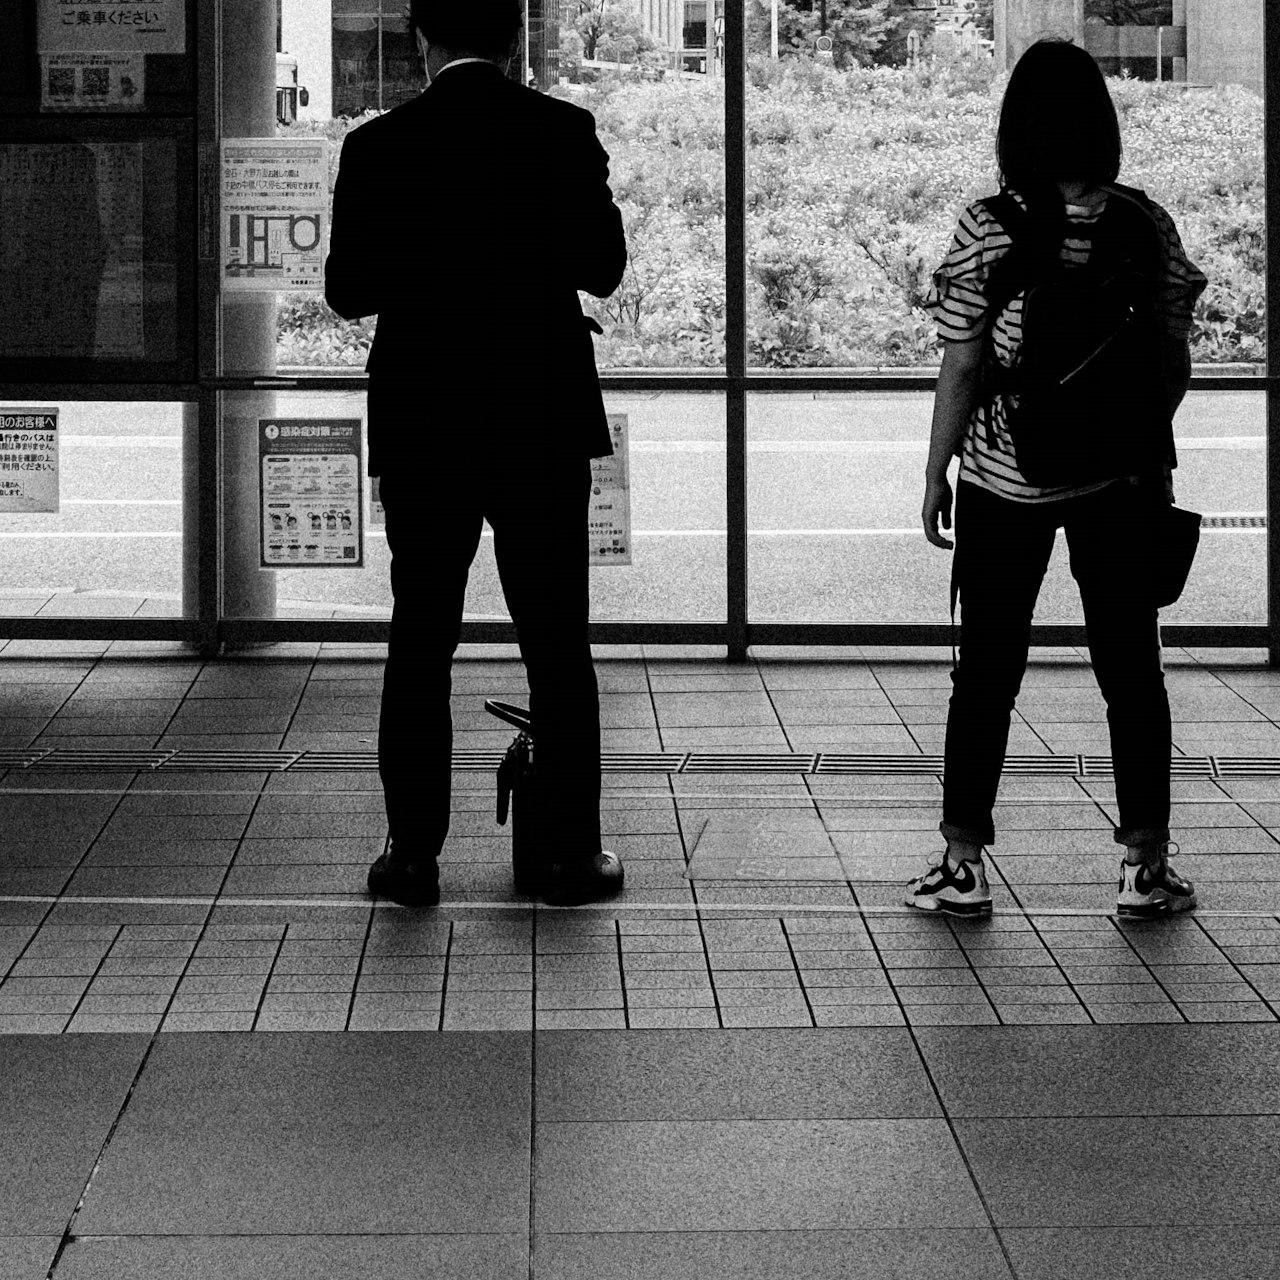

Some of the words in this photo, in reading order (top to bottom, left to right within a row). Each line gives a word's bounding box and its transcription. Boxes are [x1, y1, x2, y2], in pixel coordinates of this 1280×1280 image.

[62, 10, 159, 26] ご乗車ください
